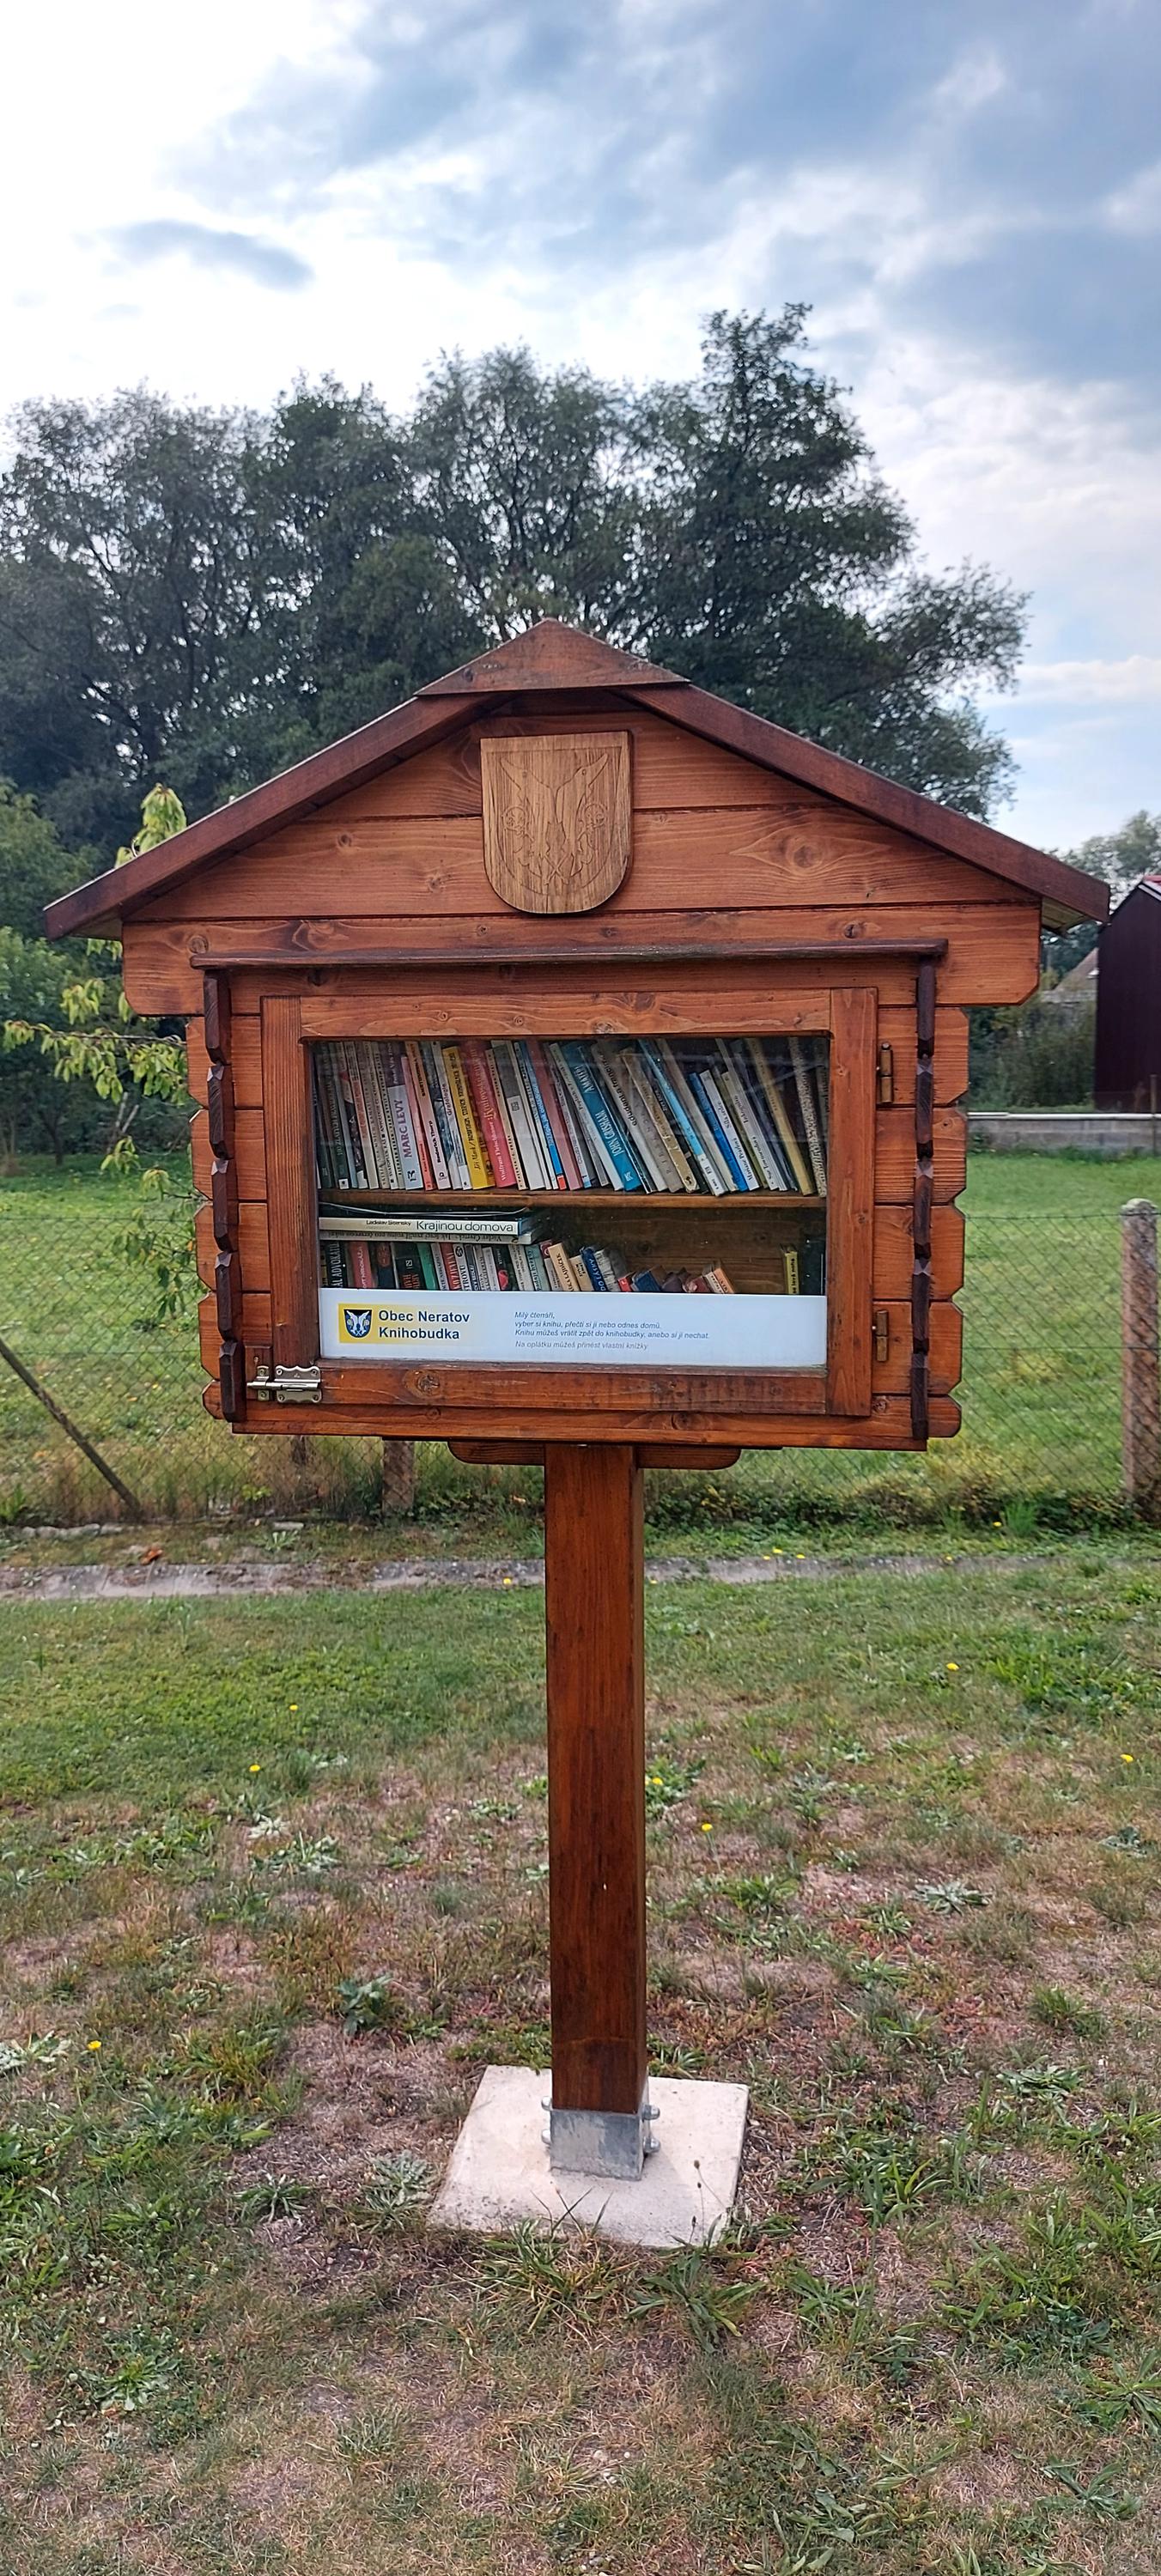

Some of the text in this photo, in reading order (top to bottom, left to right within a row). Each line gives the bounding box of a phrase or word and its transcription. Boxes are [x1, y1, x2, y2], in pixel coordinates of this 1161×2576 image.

[442, 1083, 453, 1116] Grafologie
[394, 1098, 412, 1158] MARC LEVY
[488, 1121, 501, 1155] Fleischhauer
[594, 1109, 623, 1156] JOHN GRISHAM
[496, 1155, 507, 1181] Wolfram
[416, 1220, 514, 1233] Krajinou domova
[589, 1258, 602, 1280] LÁSKY
[379, 1310, 470, 1322] Obec Neratov
[379, 1327, 459, 1340] Knihobudka
